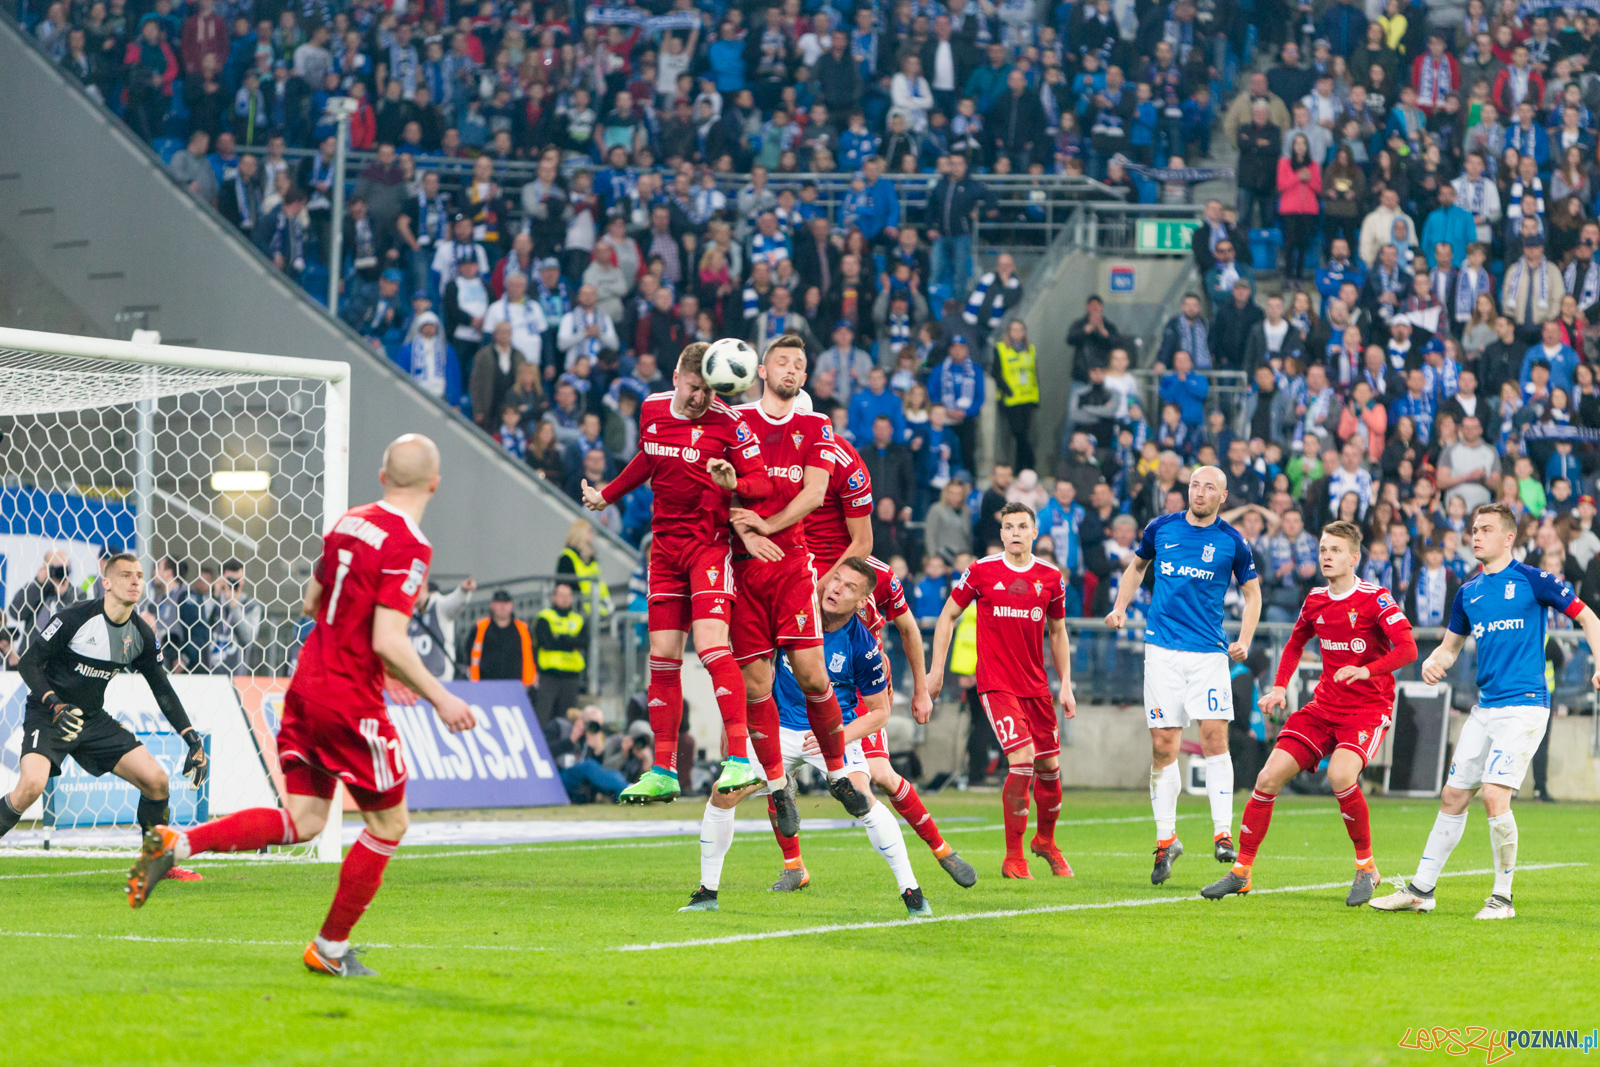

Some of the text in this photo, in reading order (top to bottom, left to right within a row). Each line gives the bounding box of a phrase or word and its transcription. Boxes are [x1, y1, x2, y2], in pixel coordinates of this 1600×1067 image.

[821, 425, 833, 440] ST
[848, 469, 865, 489] STS
[1177, 565, 1215, 580] AFORTI
[993, 606, 1030, 619] Allianz
[1487, 618, 1524, 633] AFORTI
[74, 662, 111, 680] Allianz
[1207, 688, 1218, 712] 6
[1150, 708, 1164, 720] STS
[30, 729, 40, 748] 1
[996, 716, 1019, 743] 32
[1488, 749, 1503, 774] 7
